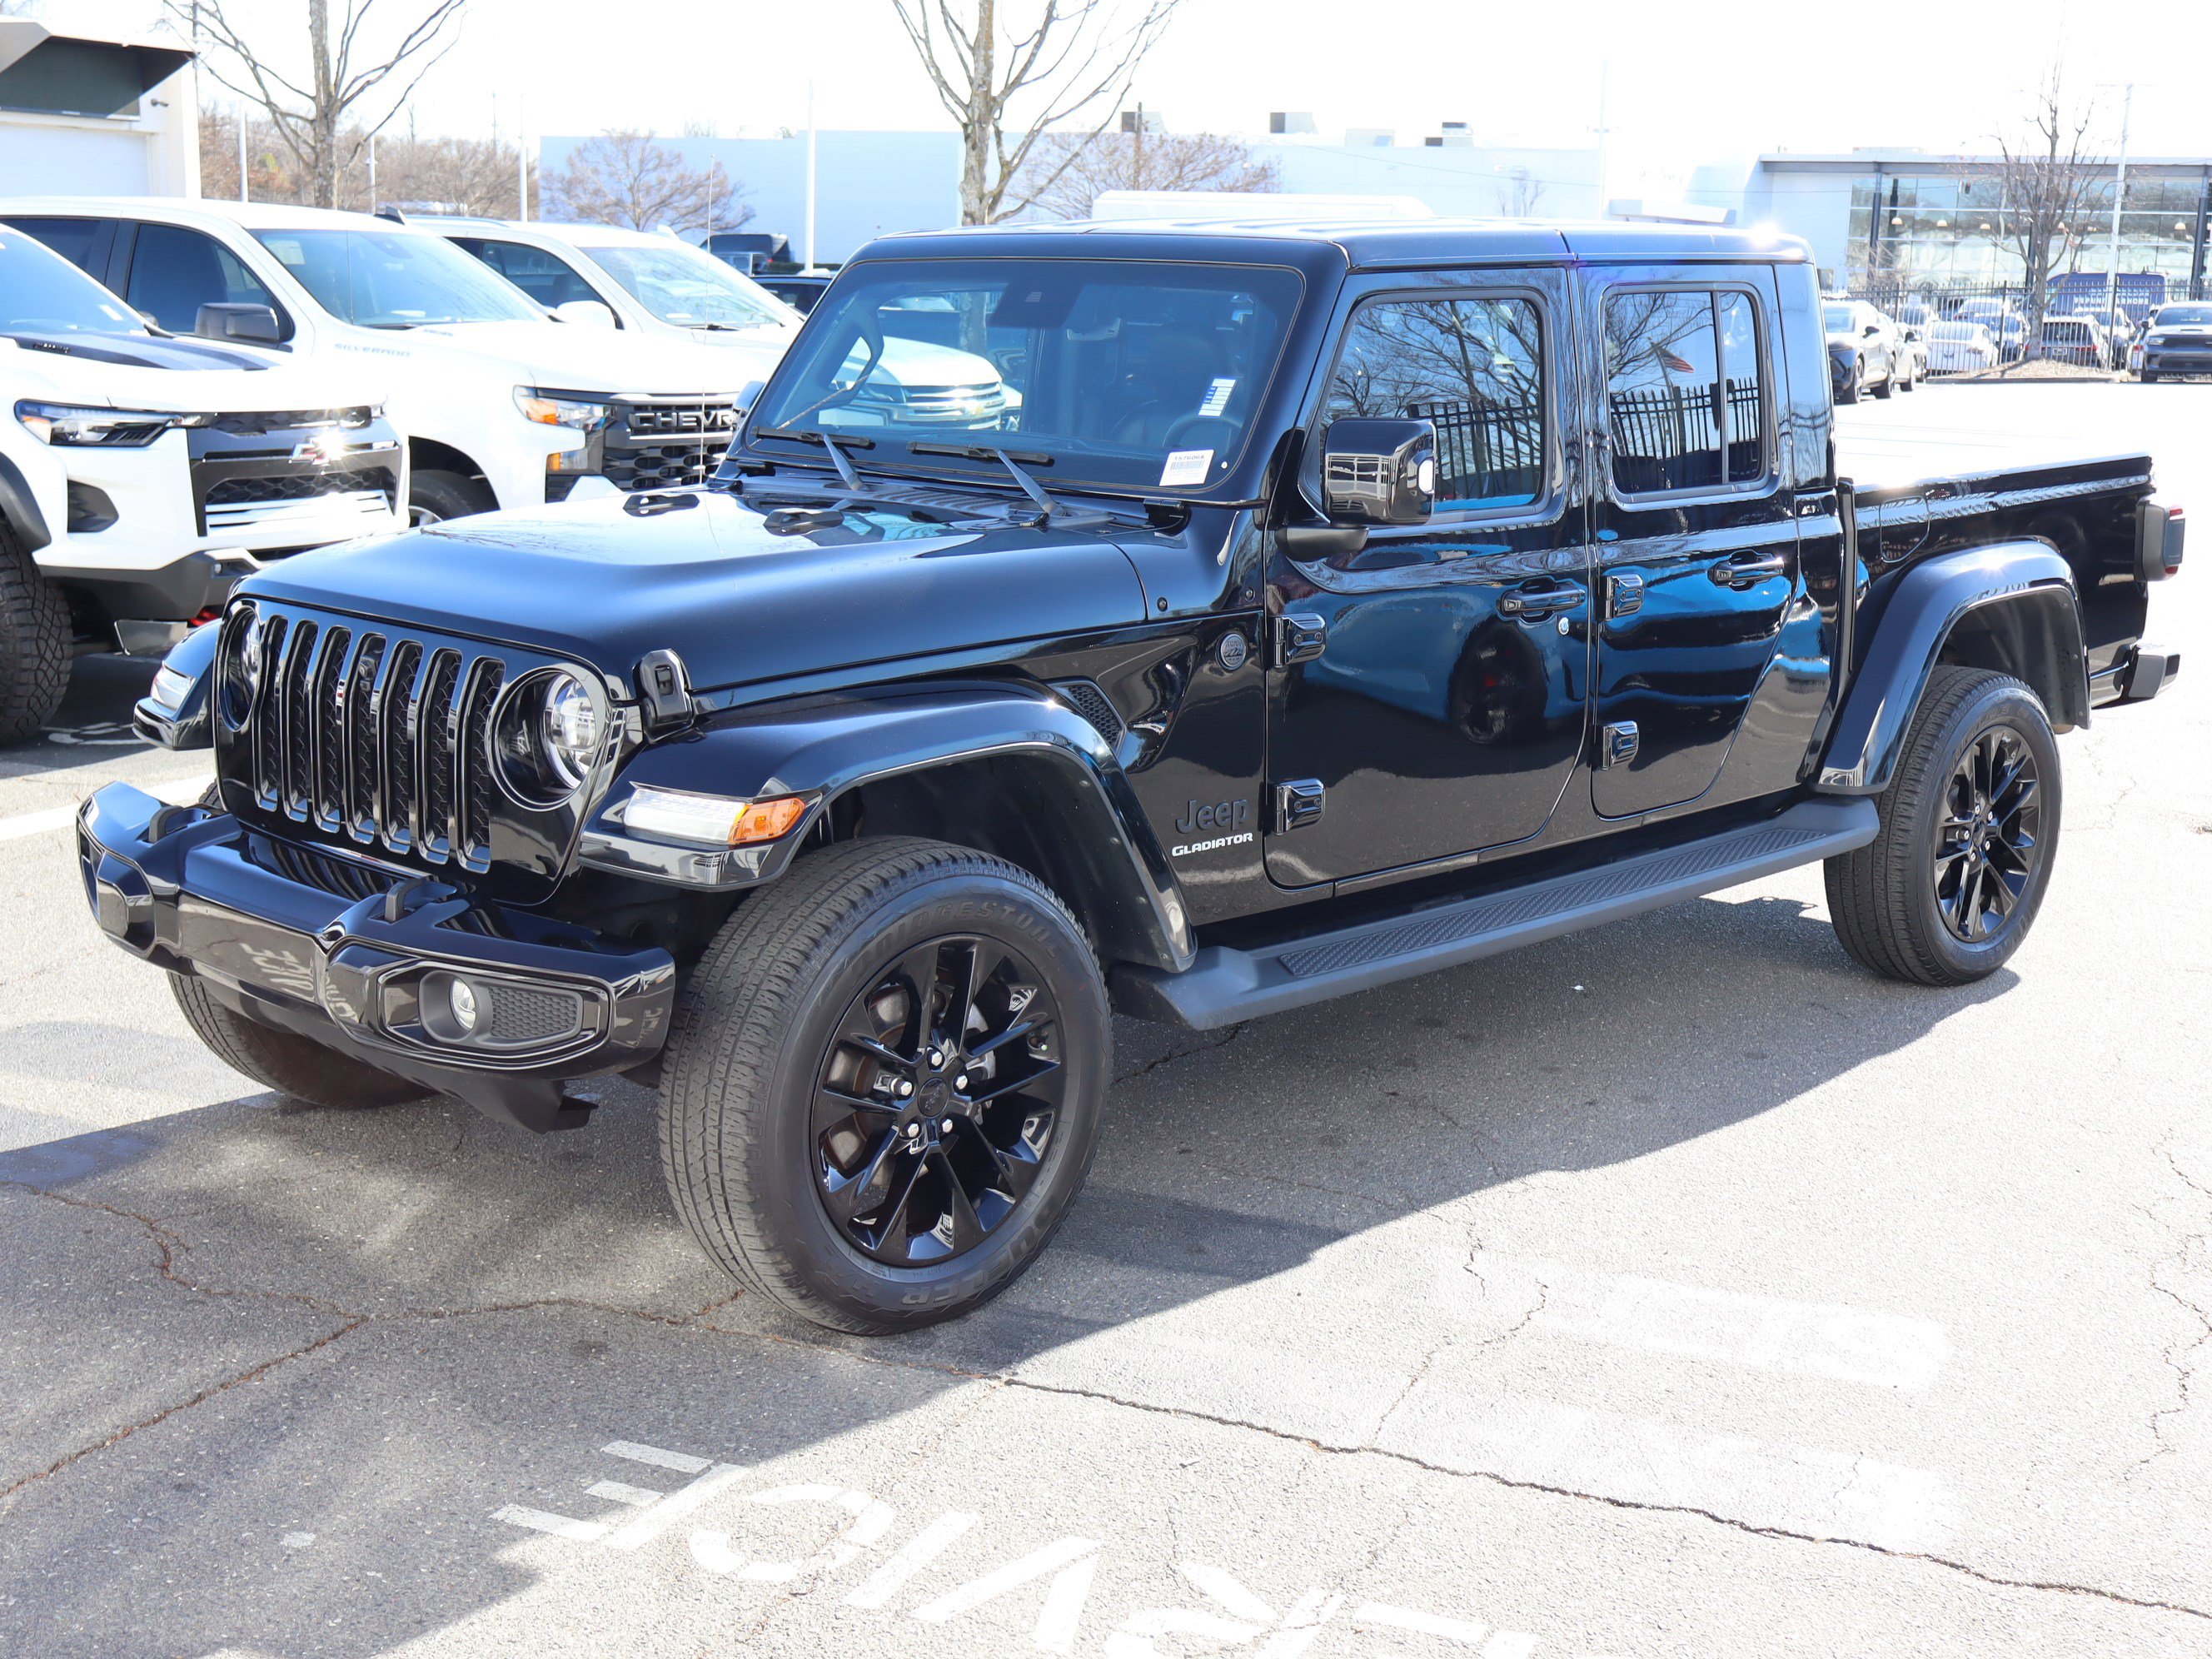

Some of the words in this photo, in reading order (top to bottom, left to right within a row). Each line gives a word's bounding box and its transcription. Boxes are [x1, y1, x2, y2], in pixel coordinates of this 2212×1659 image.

[334, 342, 411, 357] SILVERADO
[629, 409, 735, 429] CHEVR
[1175, 800, 1248, 834] Jeep
[1172, 832, 1253, 856] GLADIATOR
[489, 1440, 1537, 1659] RVICE
